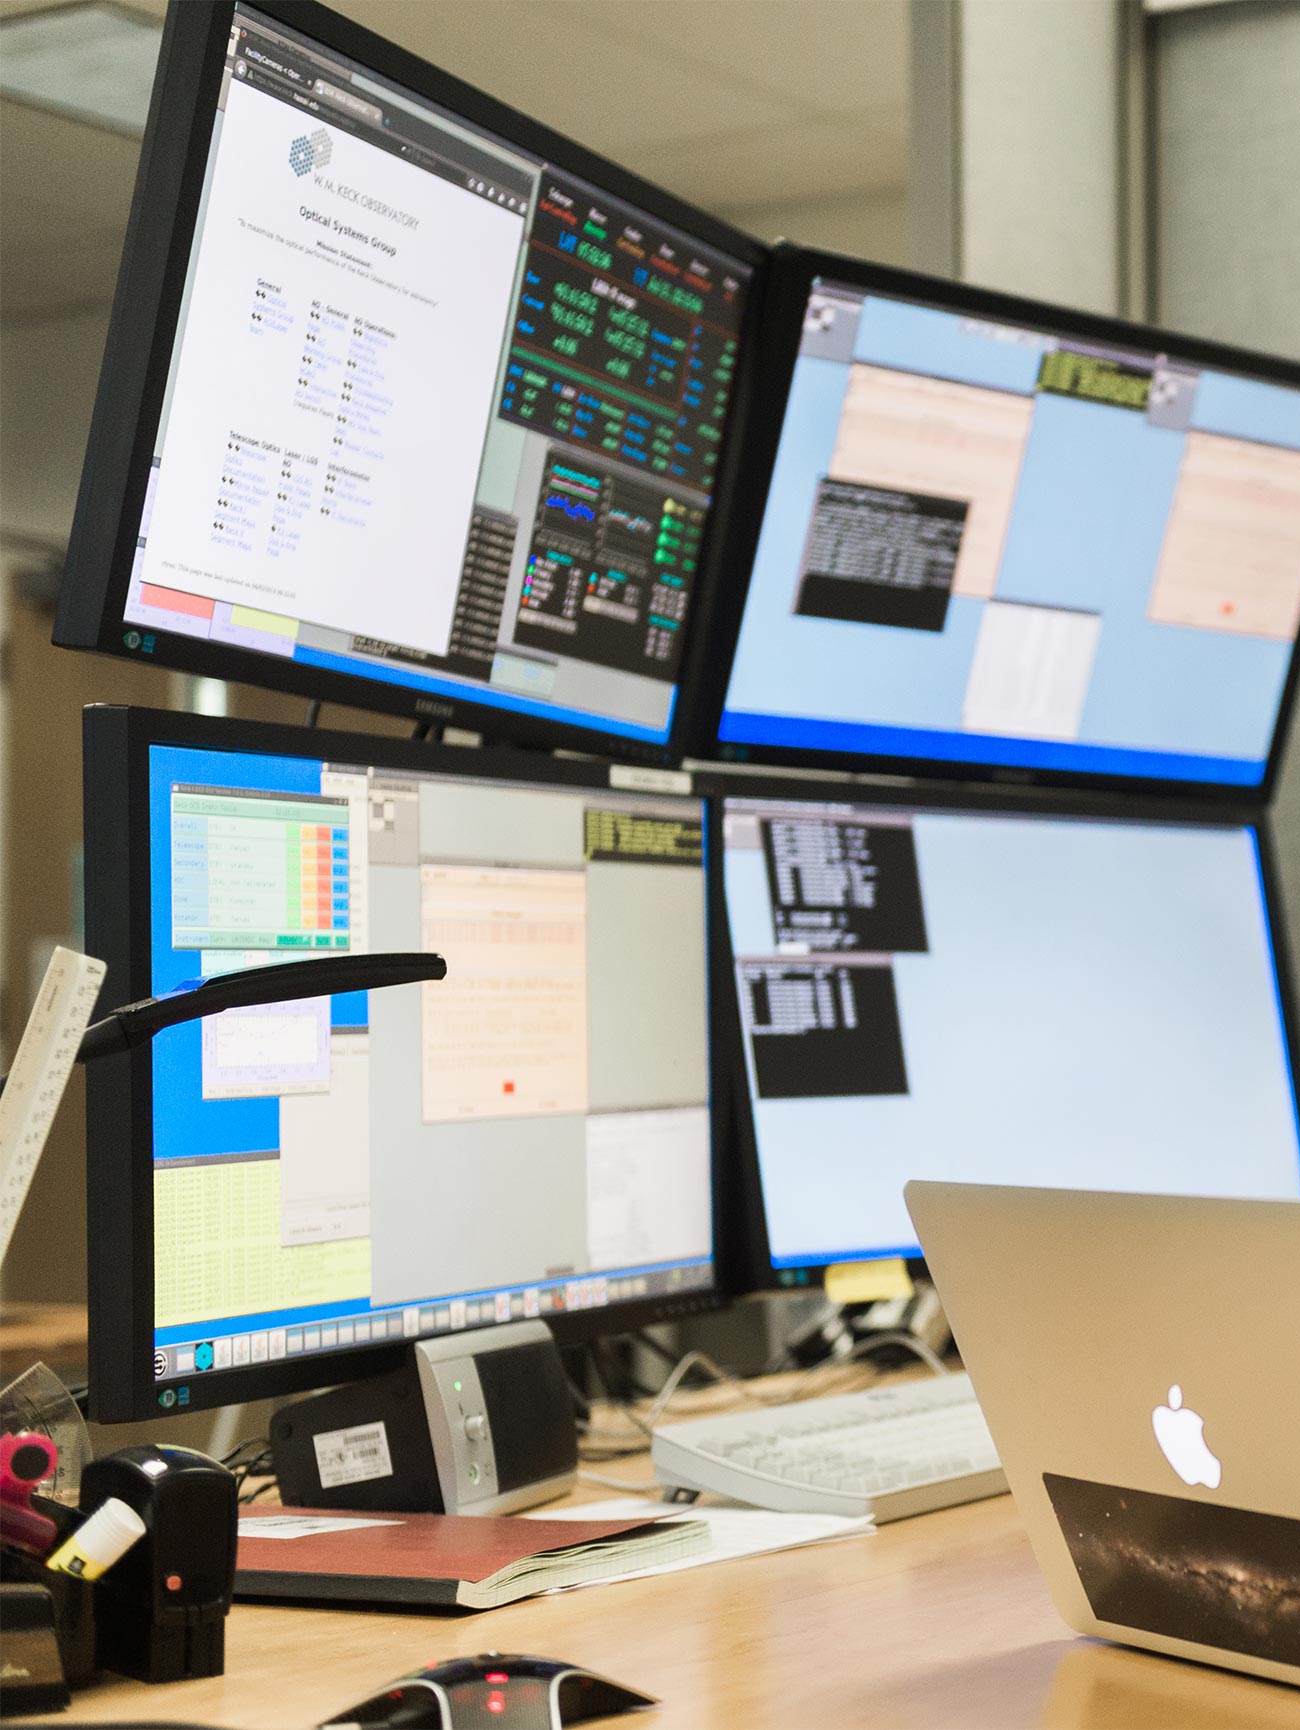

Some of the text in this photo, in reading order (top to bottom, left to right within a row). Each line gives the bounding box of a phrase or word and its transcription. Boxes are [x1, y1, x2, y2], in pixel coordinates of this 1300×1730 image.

[336, 182, 360, 204] KECK
[360, 193, 419, 231] OBSERVATORY
[298, 204, 397, 258] Optical Systems Group
[256, 277, 281, 294] General
[325, 305, 349, 321] General
[228, 430, 281, 454] Telescope Optics
[284, 448, 301, 461] Laser
